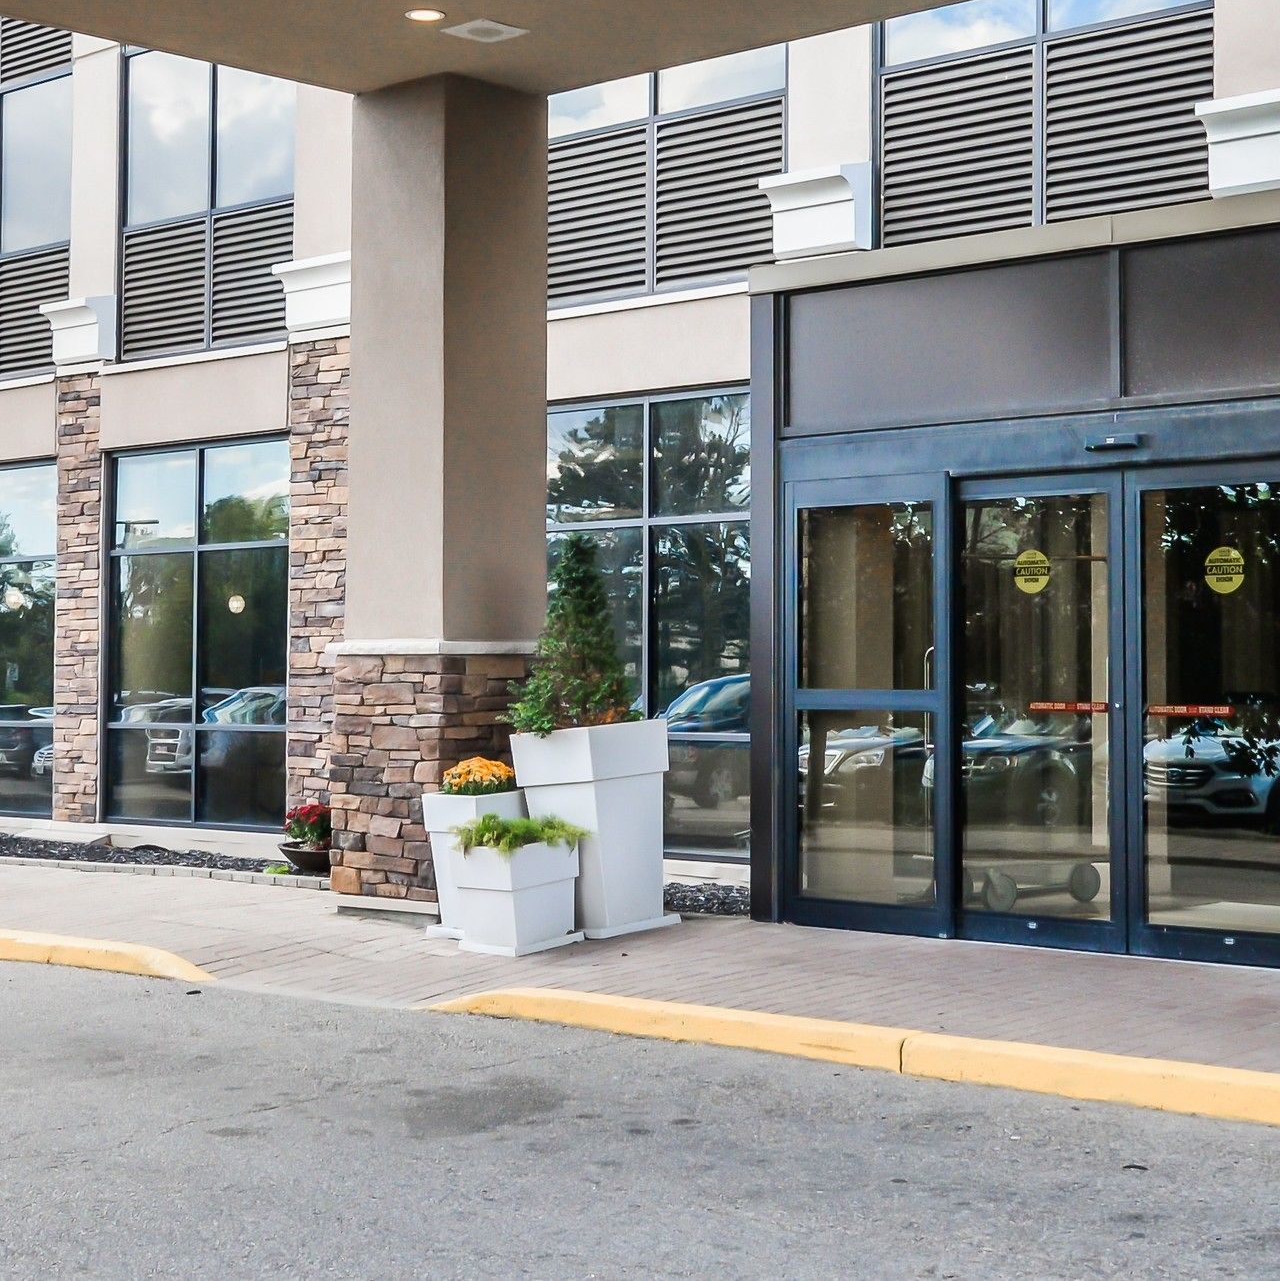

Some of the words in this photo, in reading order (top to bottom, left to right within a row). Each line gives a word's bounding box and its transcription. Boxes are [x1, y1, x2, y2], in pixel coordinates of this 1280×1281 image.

[1016, 567, 1048, 575] CAUTION
[1206, 566, 1243, 574] CAUTION
[1030, 702, 1053, 710] AUTOMATIC
[1054, 702, 1066, 710] DOOR
[1214, 706, 1229, 714] CLEAR
